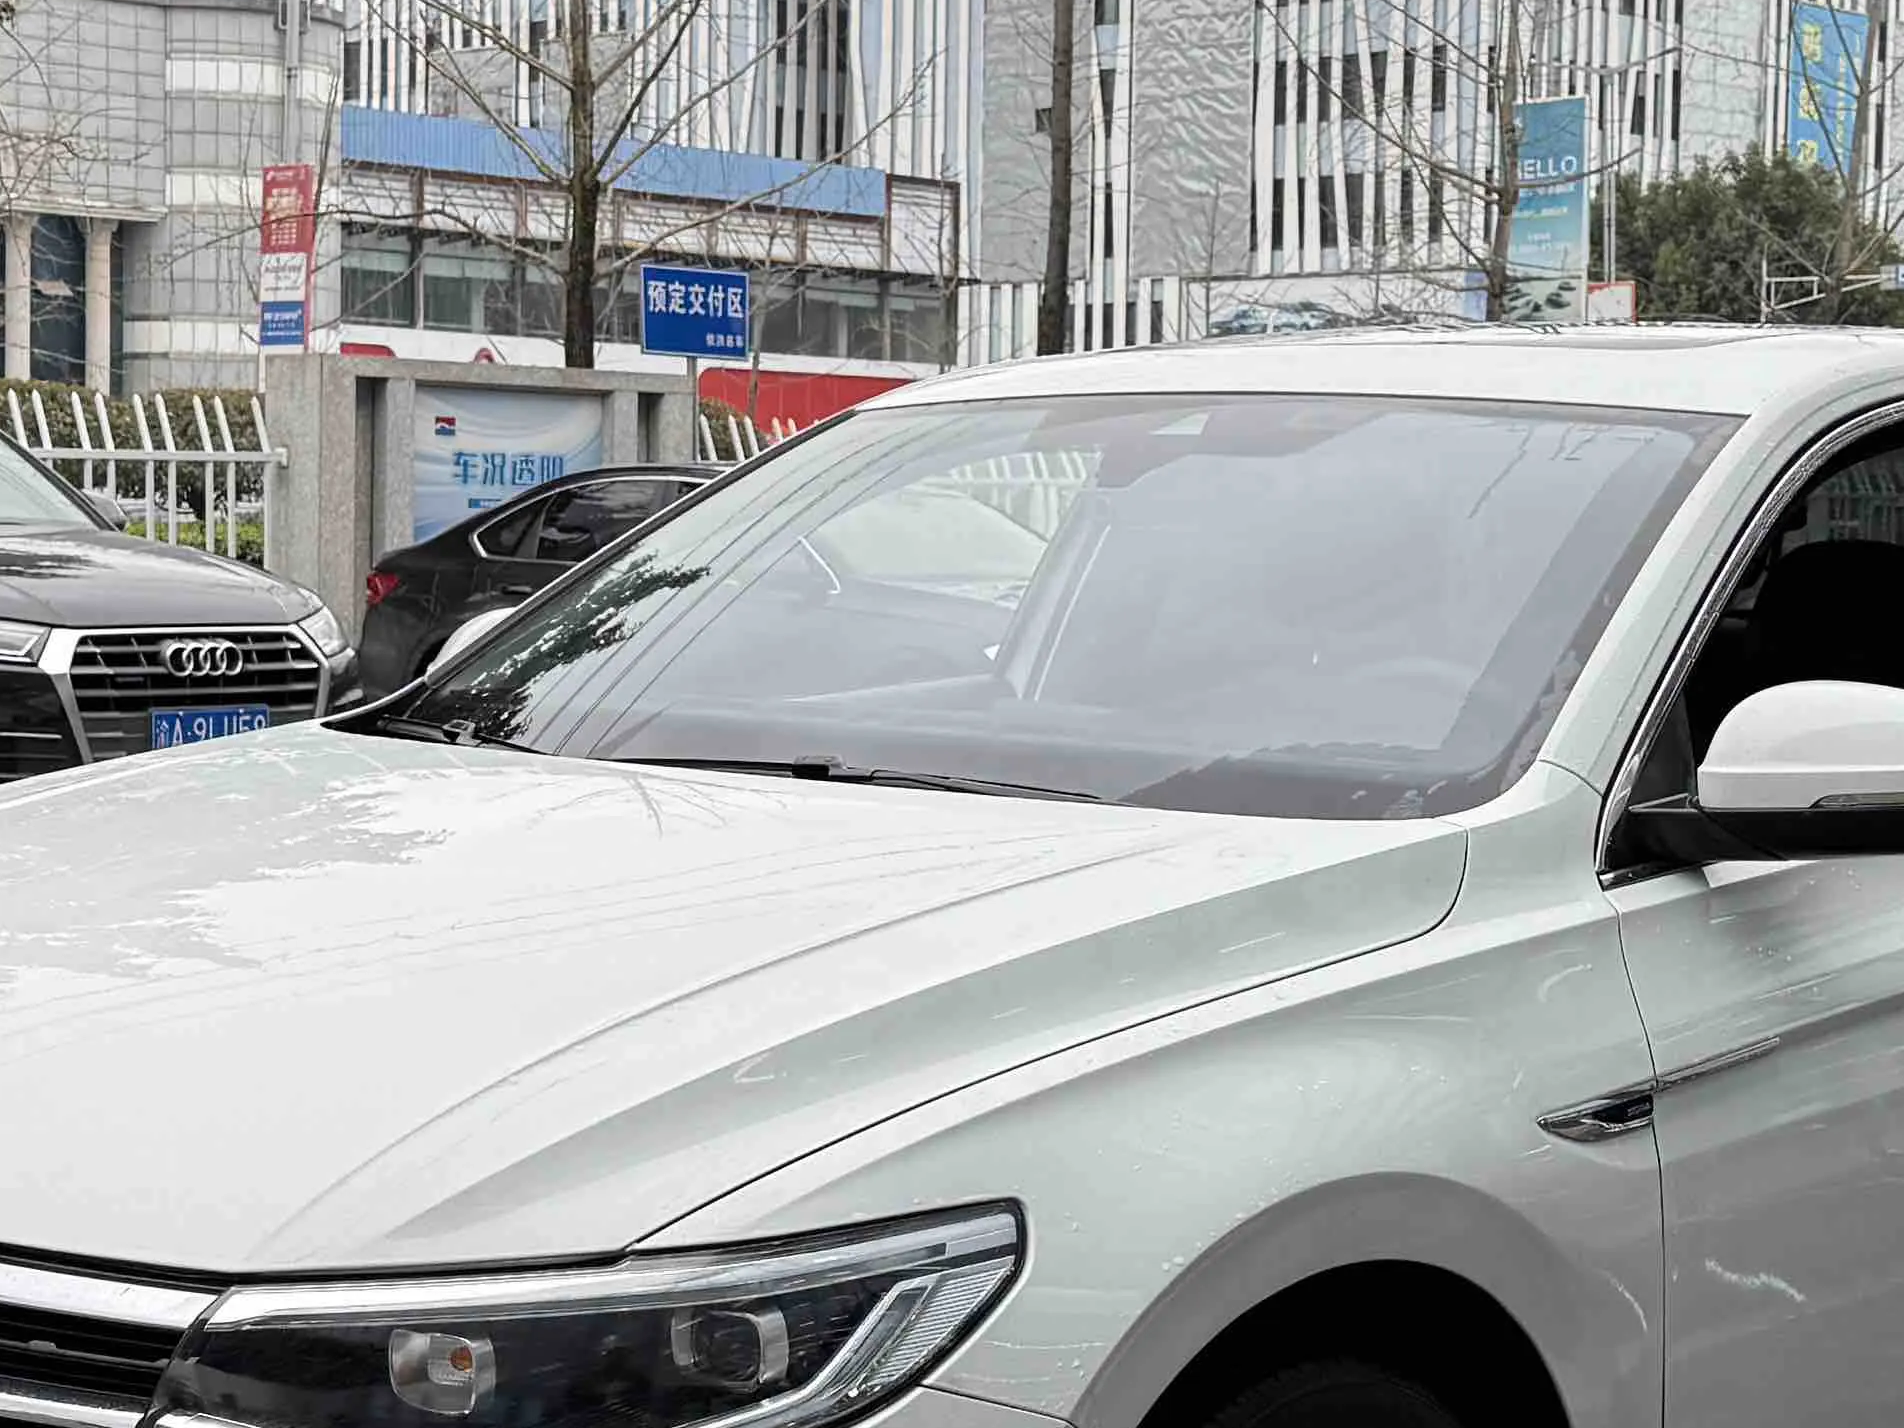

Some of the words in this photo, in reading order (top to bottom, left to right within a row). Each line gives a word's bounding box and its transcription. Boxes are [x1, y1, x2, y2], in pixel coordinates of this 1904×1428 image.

[647, 280, 744, 318] 预定交付区
